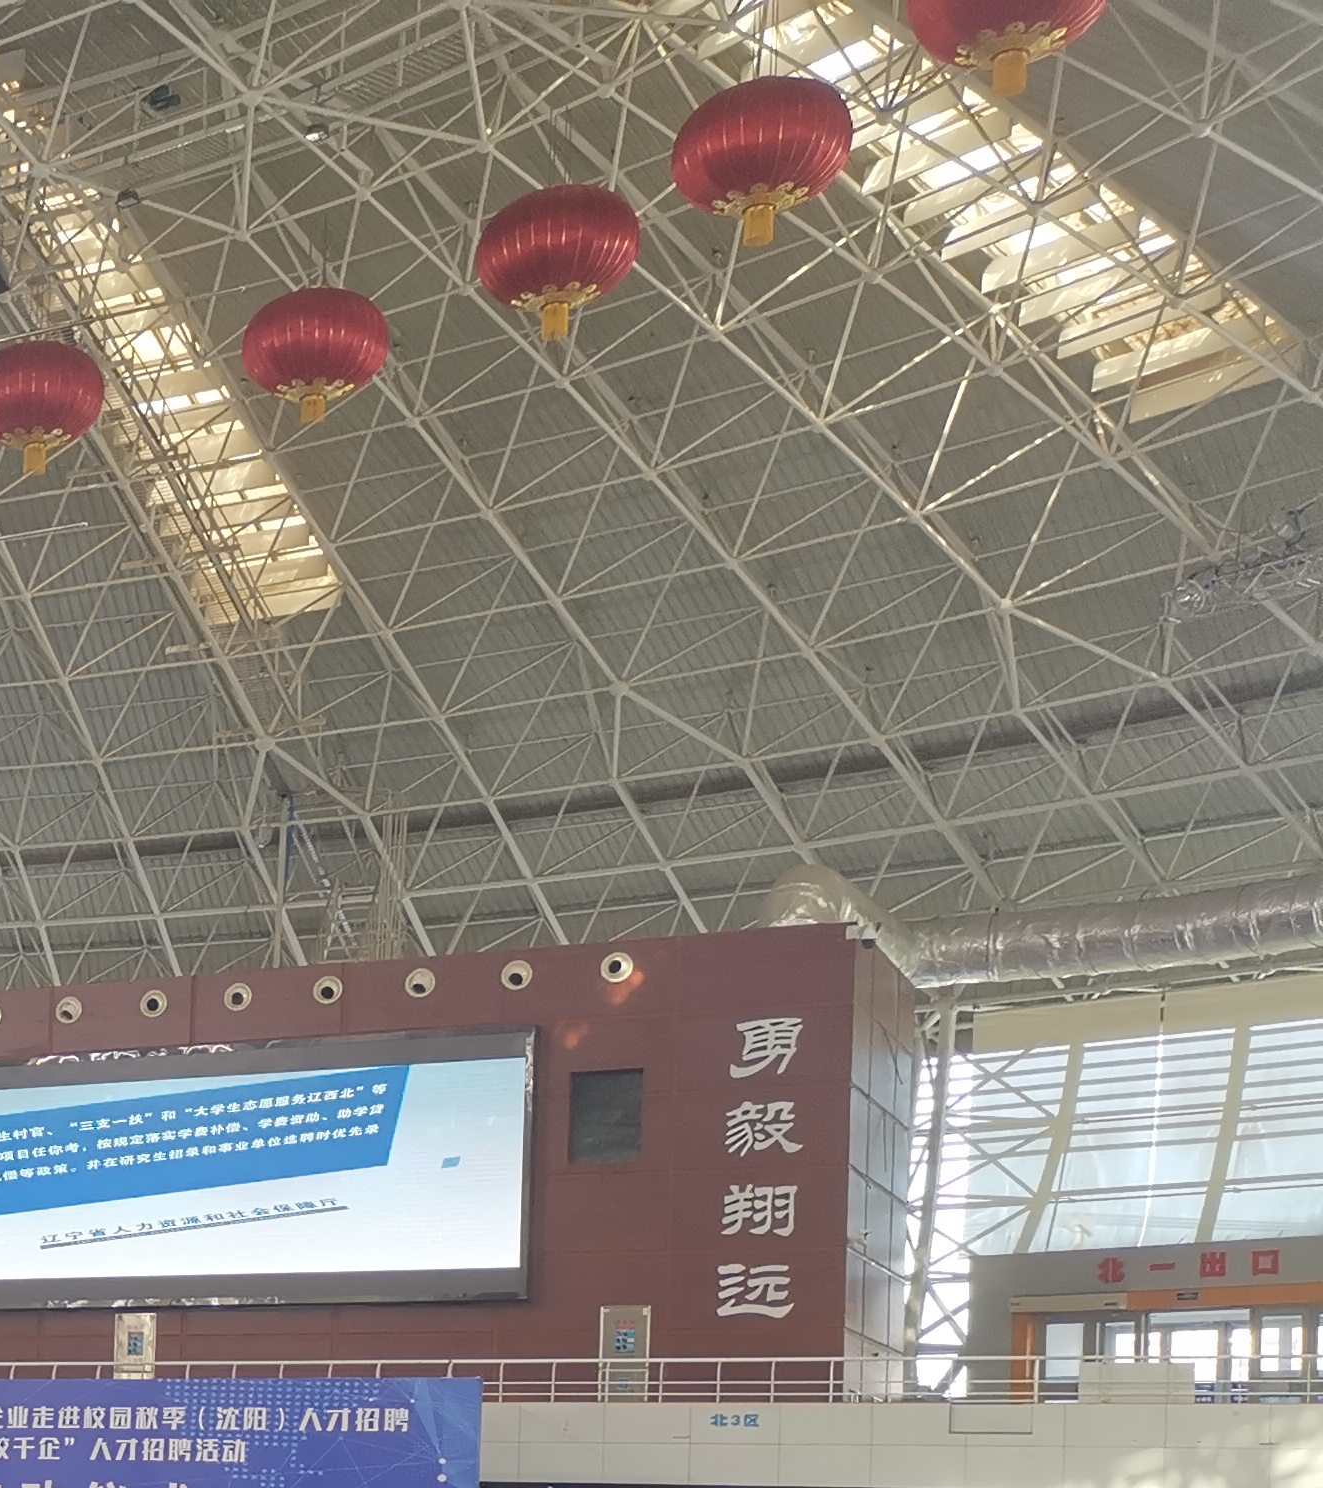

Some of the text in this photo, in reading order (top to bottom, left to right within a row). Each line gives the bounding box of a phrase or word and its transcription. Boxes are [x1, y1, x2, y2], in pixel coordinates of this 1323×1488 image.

[716, 1016, 804, 1319] 勇毅翔远
[40, 1197, 339, 1244] 辽宁省人力资源和社会保障厅
[1098, 1249, 1280, 1284] 北一出口
[710, 1414, 759, 1427] 北3区
